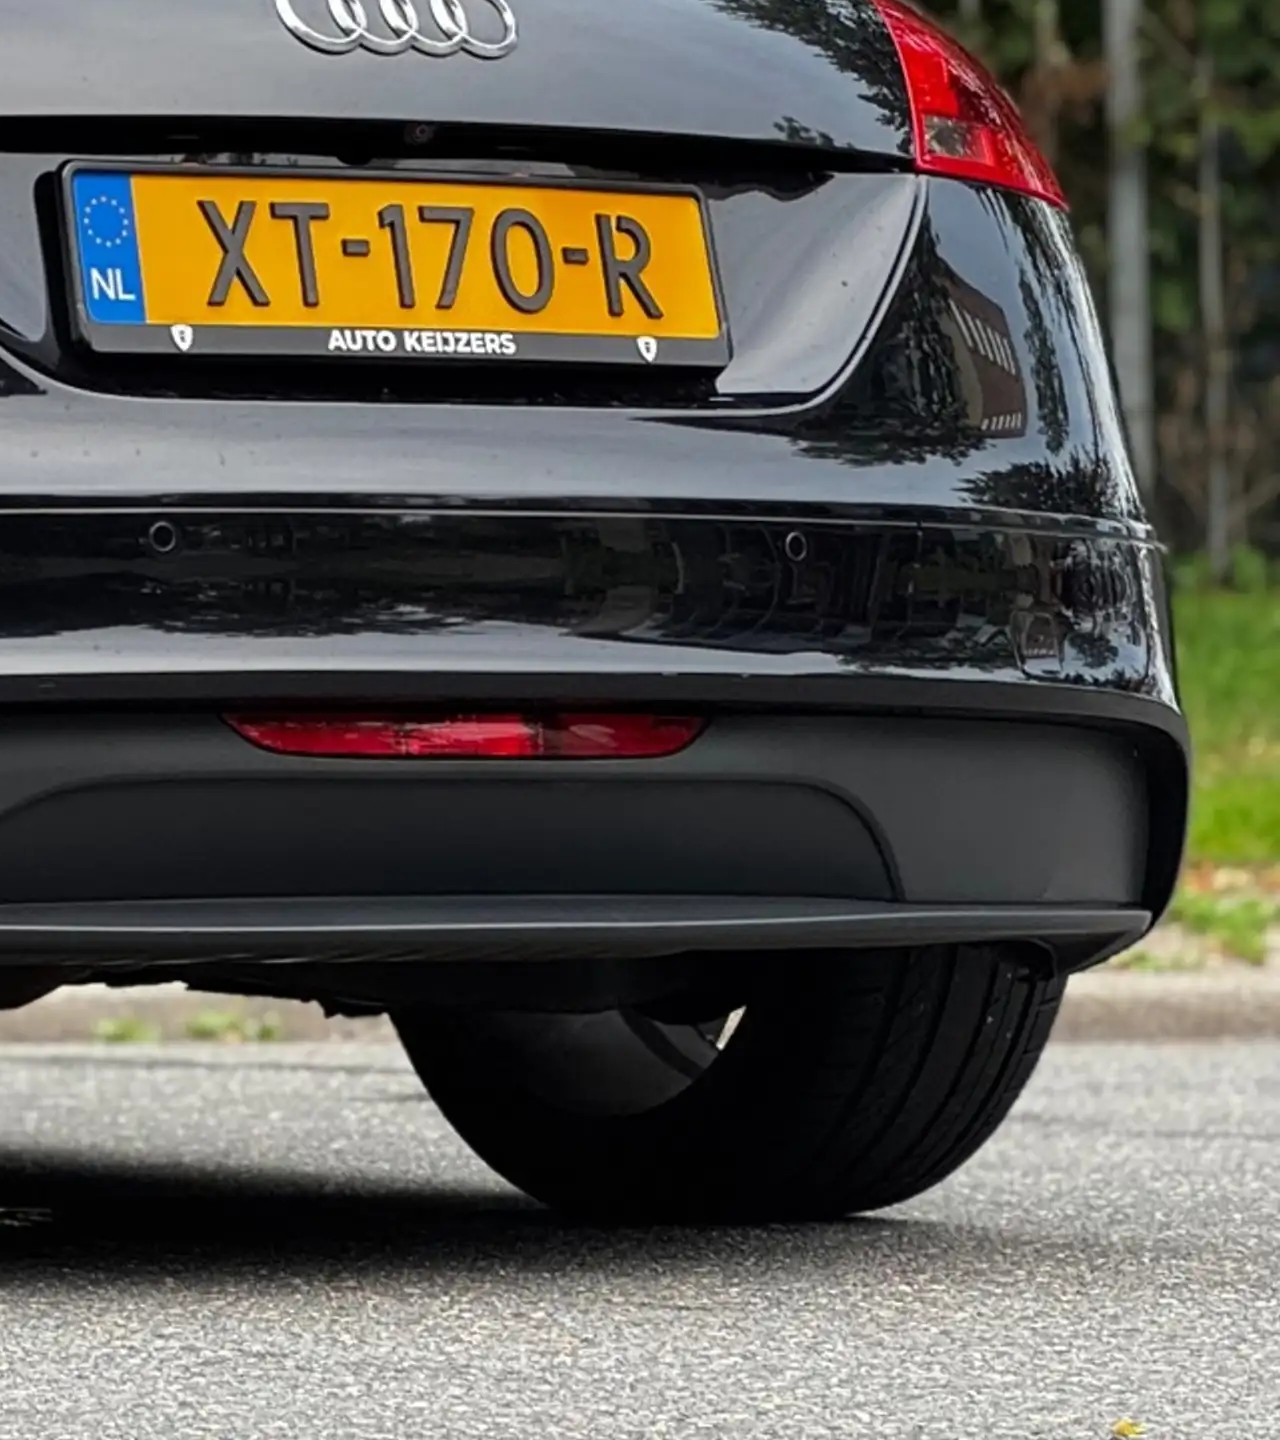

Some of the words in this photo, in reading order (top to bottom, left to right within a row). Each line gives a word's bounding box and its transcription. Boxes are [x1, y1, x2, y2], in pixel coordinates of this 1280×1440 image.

[196, 198, 663, 320] XT-170-R
[90, 267, 135, 303] NL
[328, 328, 397, 353] AUTO
[403, 330, 517, 355] KEIJZERS
